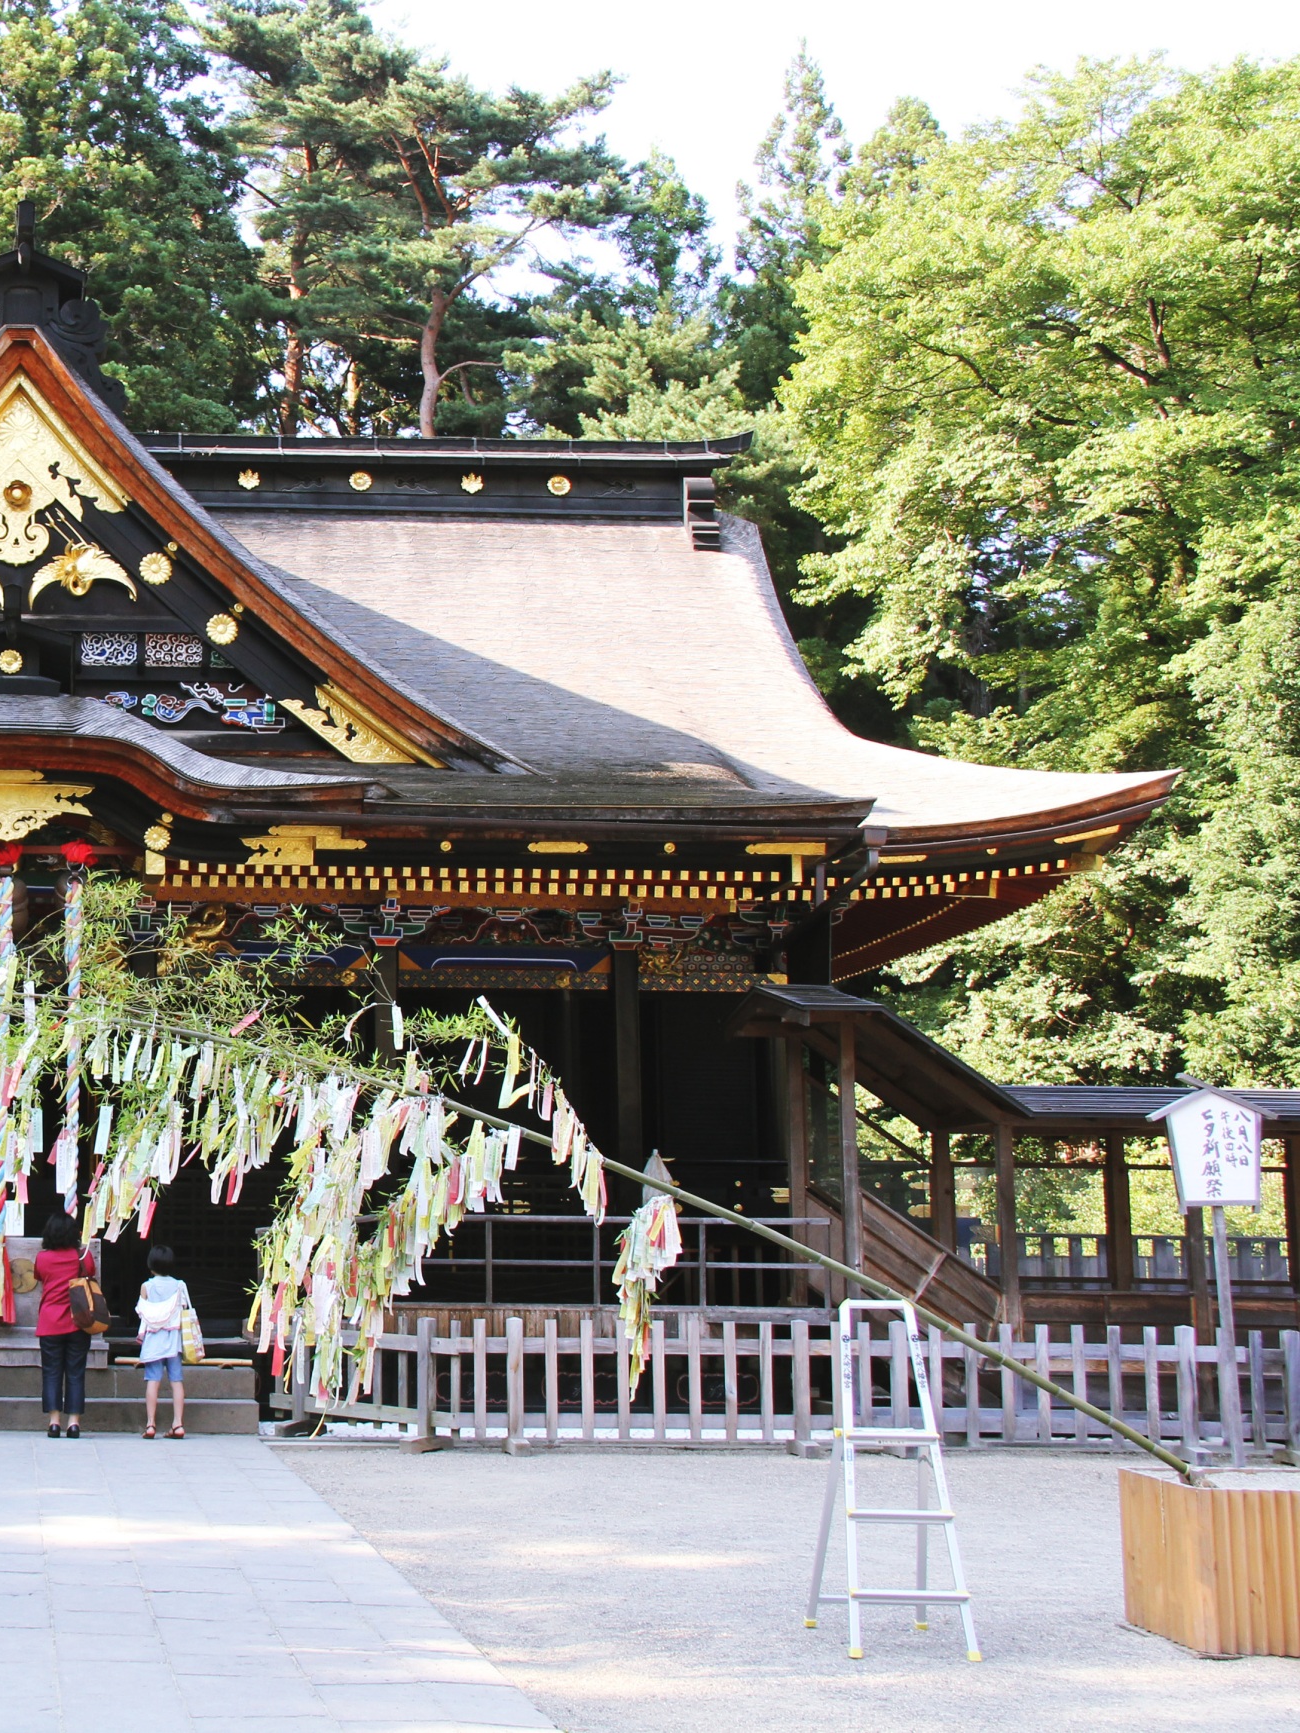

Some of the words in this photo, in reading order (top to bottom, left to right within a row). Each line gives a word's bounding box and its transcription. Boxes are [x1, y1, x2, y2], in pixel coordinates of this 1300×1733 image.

[1201, 1109, 1223, 1198] 七夕祈願祭
[1234, 1110, 1254, 1167] 八月八日
